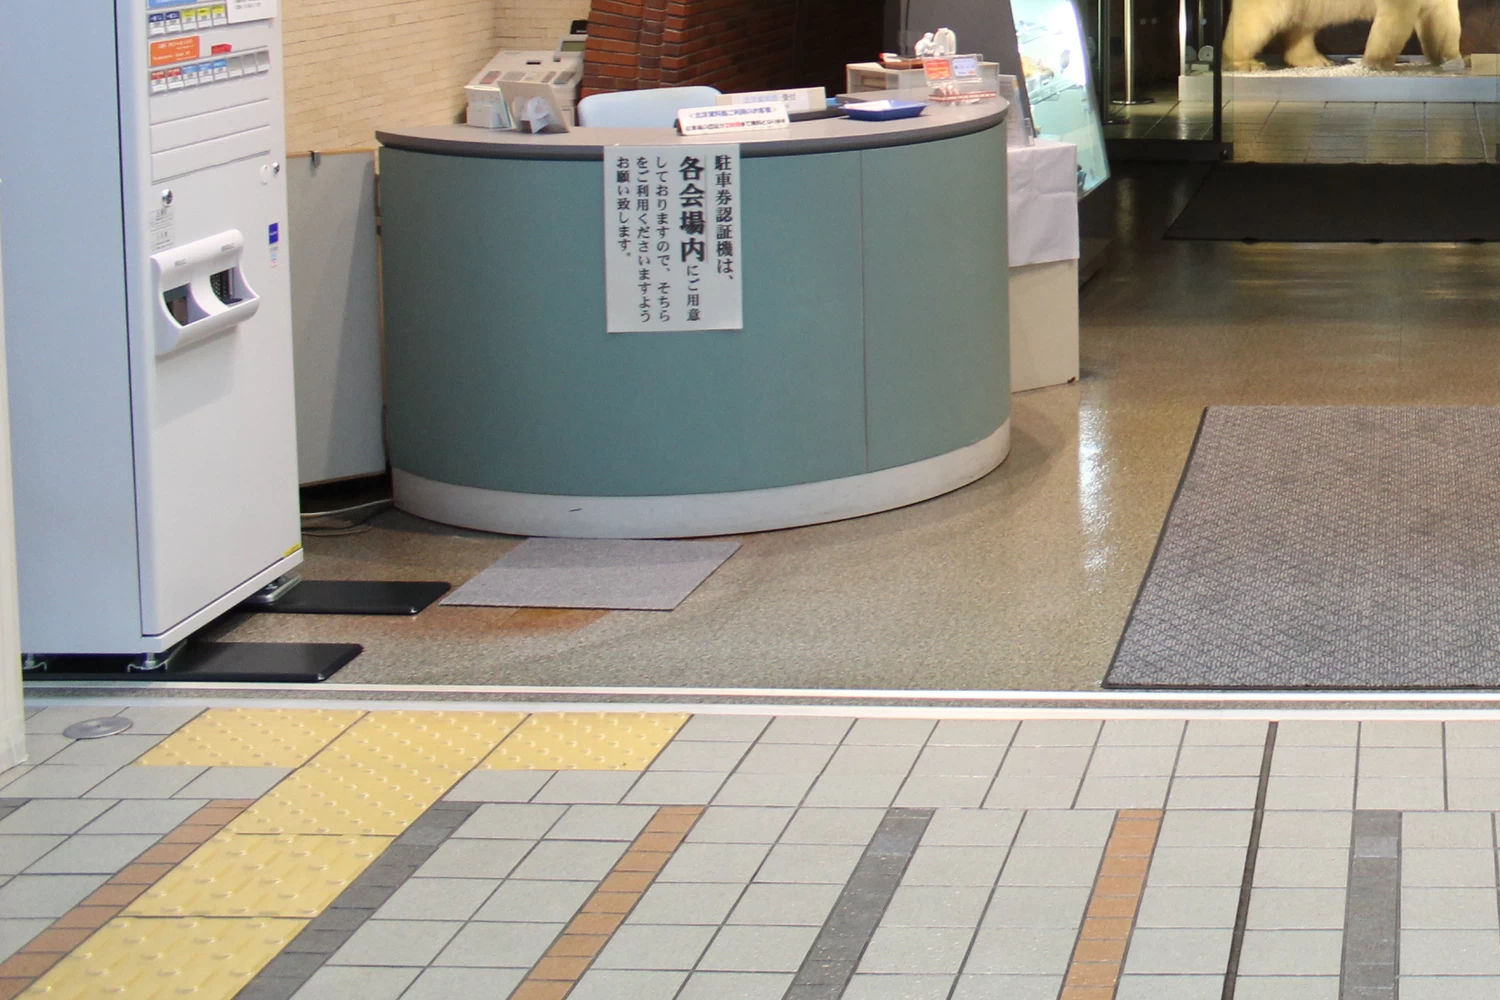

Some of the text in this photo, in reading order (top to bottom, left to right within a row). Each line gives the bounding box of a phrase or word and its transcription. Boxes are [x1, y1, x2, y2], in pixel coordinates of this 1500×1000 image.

[616, 156, 631, 257] お願い致します。
[636, 156, 651, 323] をご利用くださいますよう
[679, 156, 705, 322] 各会場内にご用意
[714, 155, 733, 280] 駐車券認証機は、
